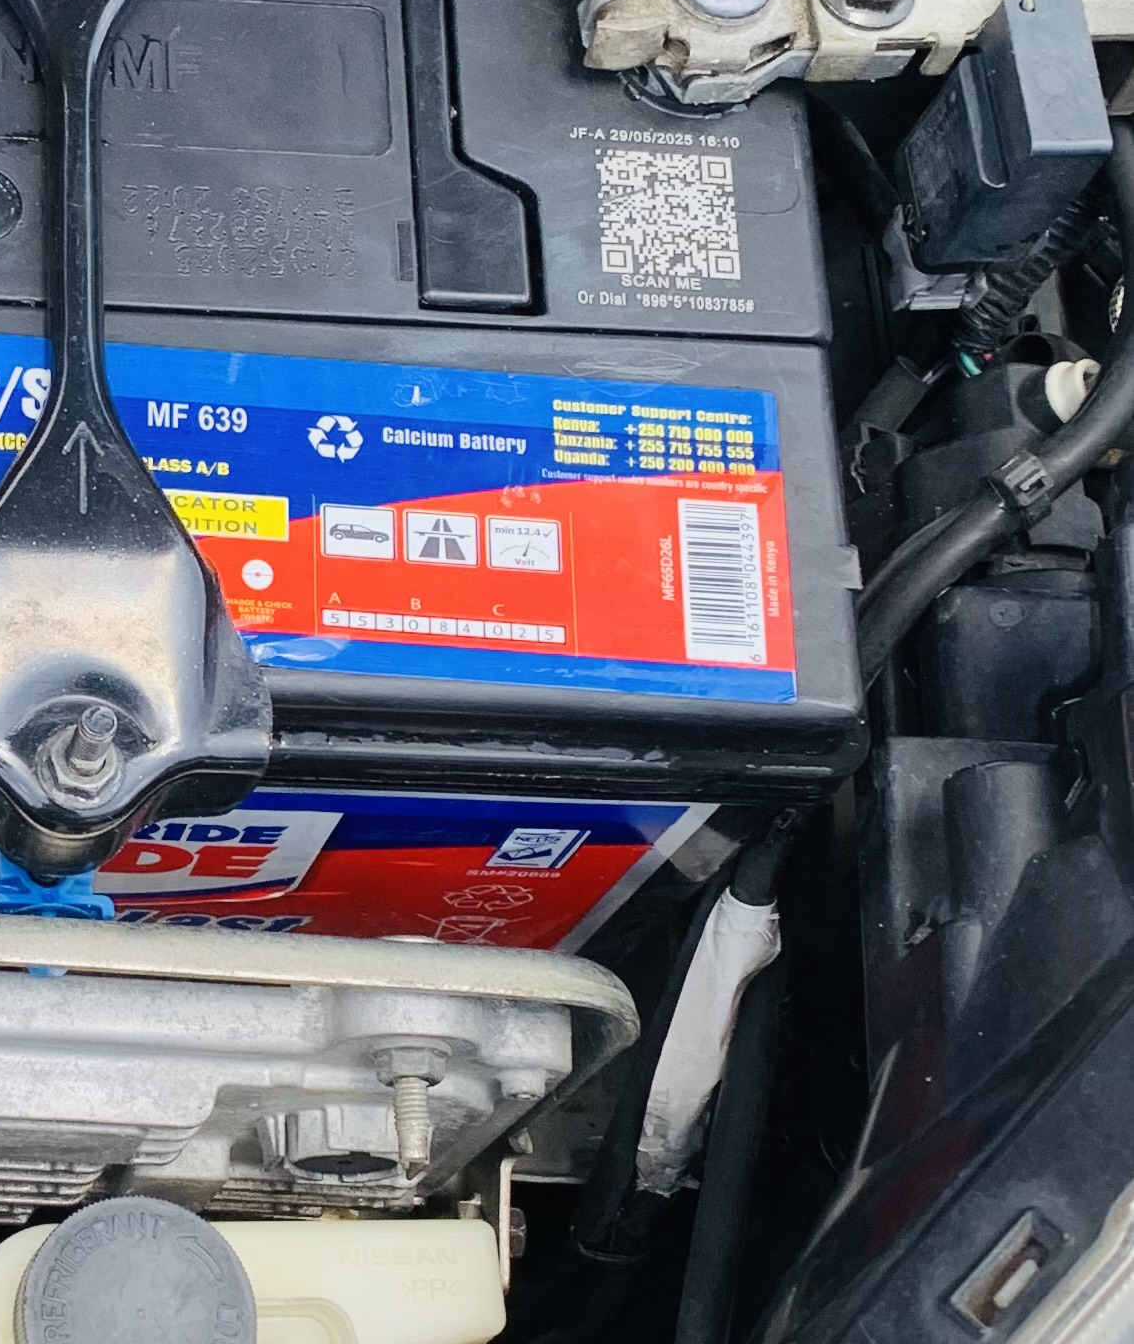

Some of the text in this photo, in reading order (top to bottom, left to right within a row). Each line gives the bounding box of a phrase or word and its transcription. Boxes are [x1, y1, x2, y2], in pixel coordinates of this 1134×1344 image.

[569, 127, 606, 141] JF-A
[609, 129, 693, 146] 29/05/2025
[620, 274, 702, 291] SCAN ME
[577, 290, 594, 305] Or
[599, 291, 627, 306] Dial
[147, 400, 249, 433] MF 639
[552, 399, 753, 425] Customer Support Centre:
[553, 416, 600, 433] Kenya:
[382, 426, 527, 455] Calcium Battery
[553, 432, 618, 451] Tanzania:
[668, 441, 692, 456] 715
[696, 443, 723, 458] 755
[727, 444, 754, 460] 555
[142, 457, 192, 473] LASS
[196, 460, 230, 476] A/B
[554, 449, 610, 467] Uganda:
[668, 457, 694, 472] 200
[541, 468, 581, 481] Customer
[583, 473, 616, 485] support
[685, 480, 700, 489] are
[701, 481, 733, 493] country
[170, 495, 258, 514] CATOR
[495, 526, 541, 536] min 12.4
[514, 558, 535, 567] Volt
[659, 534, 675, 601] MF65D26L
[740, 513, 762, 662] 6 161108 044397
[766, 540, 779, 618] Made in Kenya
[238, 606, 276, 615] BATTERY
[328, 592, 505, 616] A B C
[338, 1247, 458, 1266] NISSAN
[41, 1212, 168, 1344] REFRIGERANT
